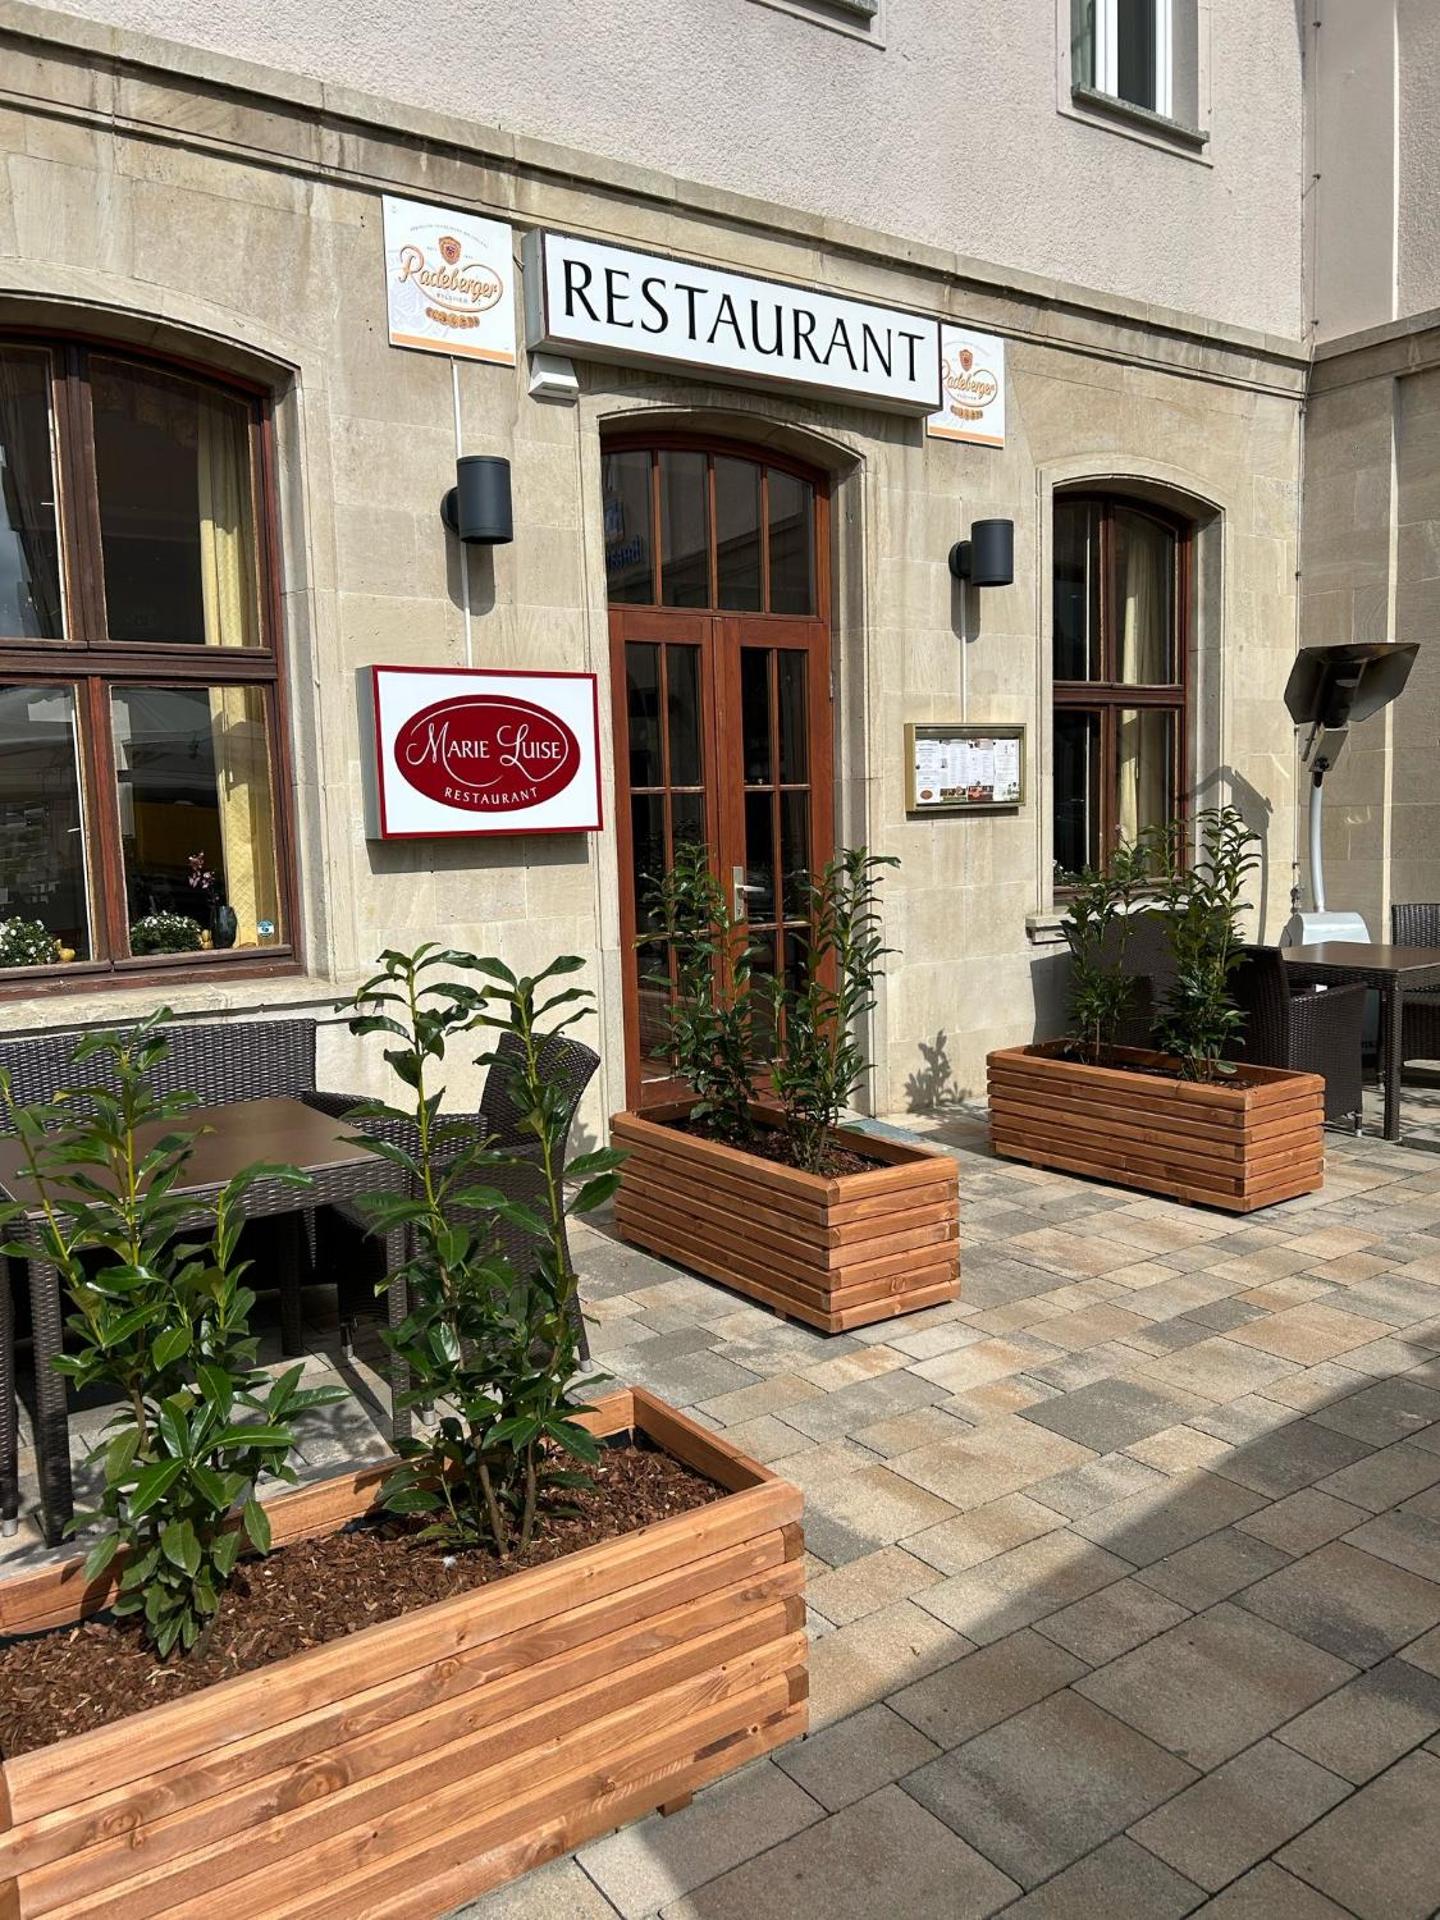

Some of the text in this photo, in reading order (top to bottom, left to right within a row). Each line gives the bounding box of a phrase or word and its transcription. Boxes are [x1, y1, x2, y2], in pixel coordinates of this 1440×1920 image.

[398, 246, 498, 303] Radeberger
[562, 258, 926, 383] RESTAURANT
[444, 786, 538, 806] RESTAURANT
